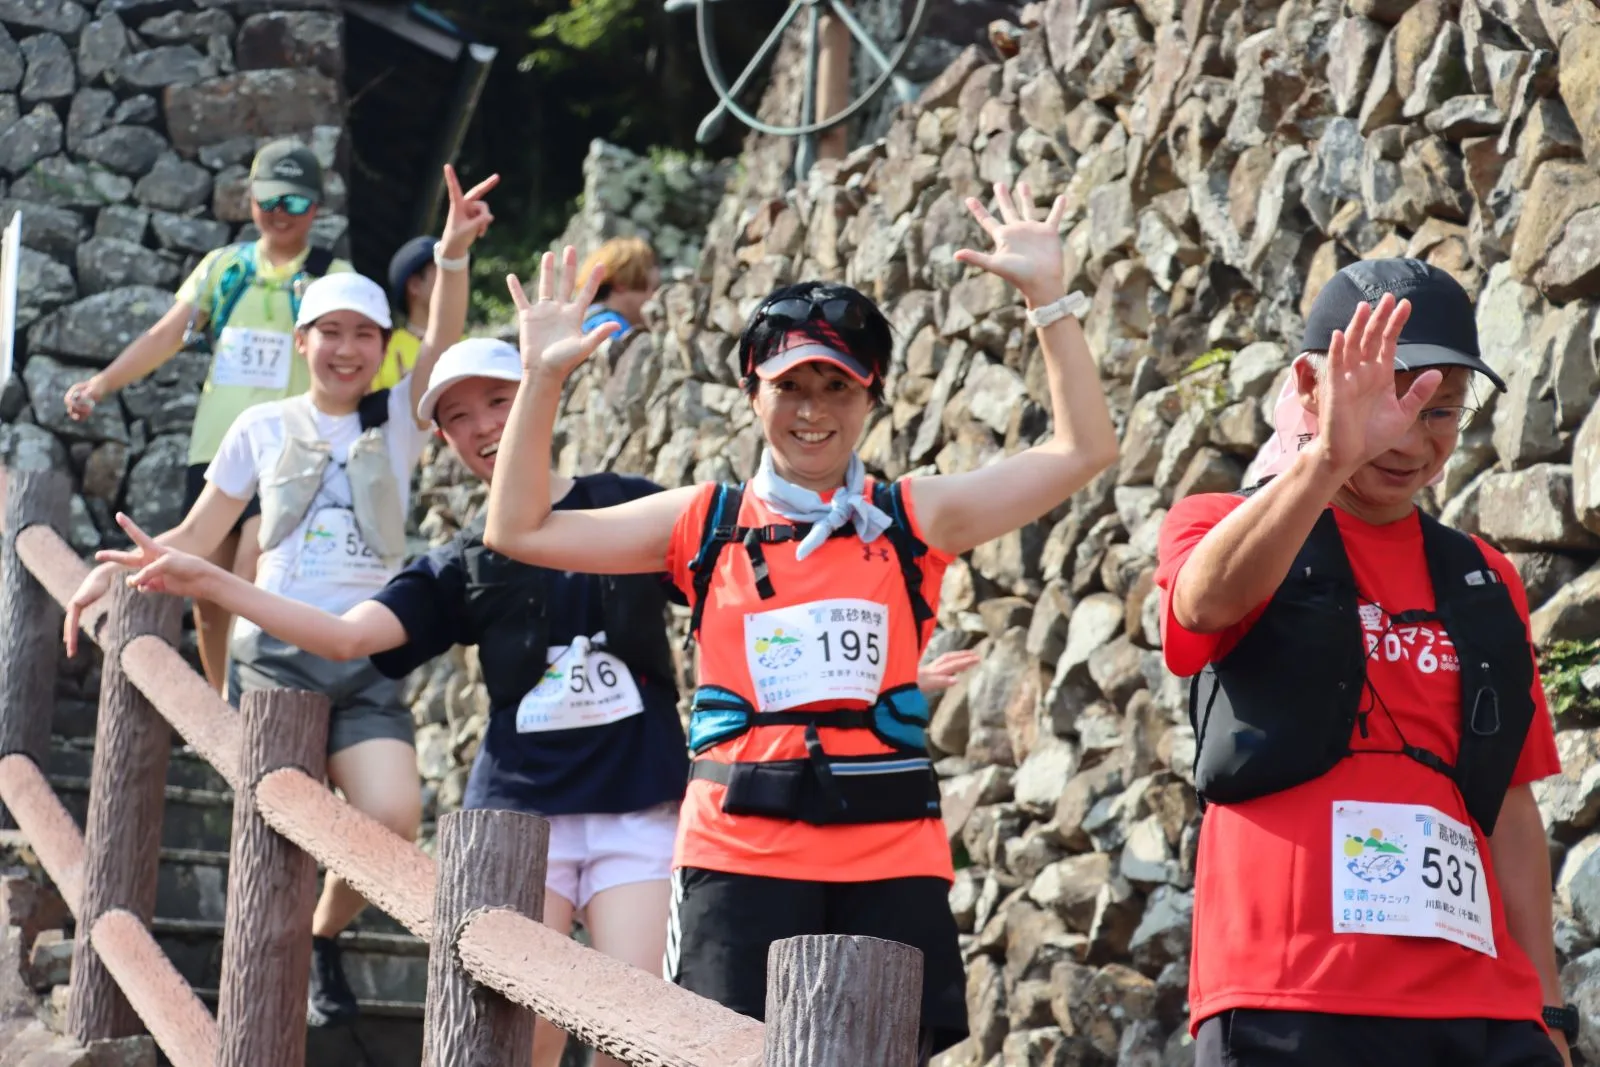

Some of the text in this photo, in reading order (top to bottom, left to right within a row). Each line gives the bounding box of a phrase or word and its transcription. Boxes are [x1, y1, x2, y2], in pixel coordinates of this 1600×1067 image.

[240, 346, 281, 368] 517
[830, 607, 882, 627] 高砂熱学
[816, 629, 880, 666] 195
[570, 660, 617, 694] 56
[1438, 822, 1478, 857] 高砂熱学
[1421, 846, 1478, 903] 537
[1343, 908, 1385, 922] 2026
